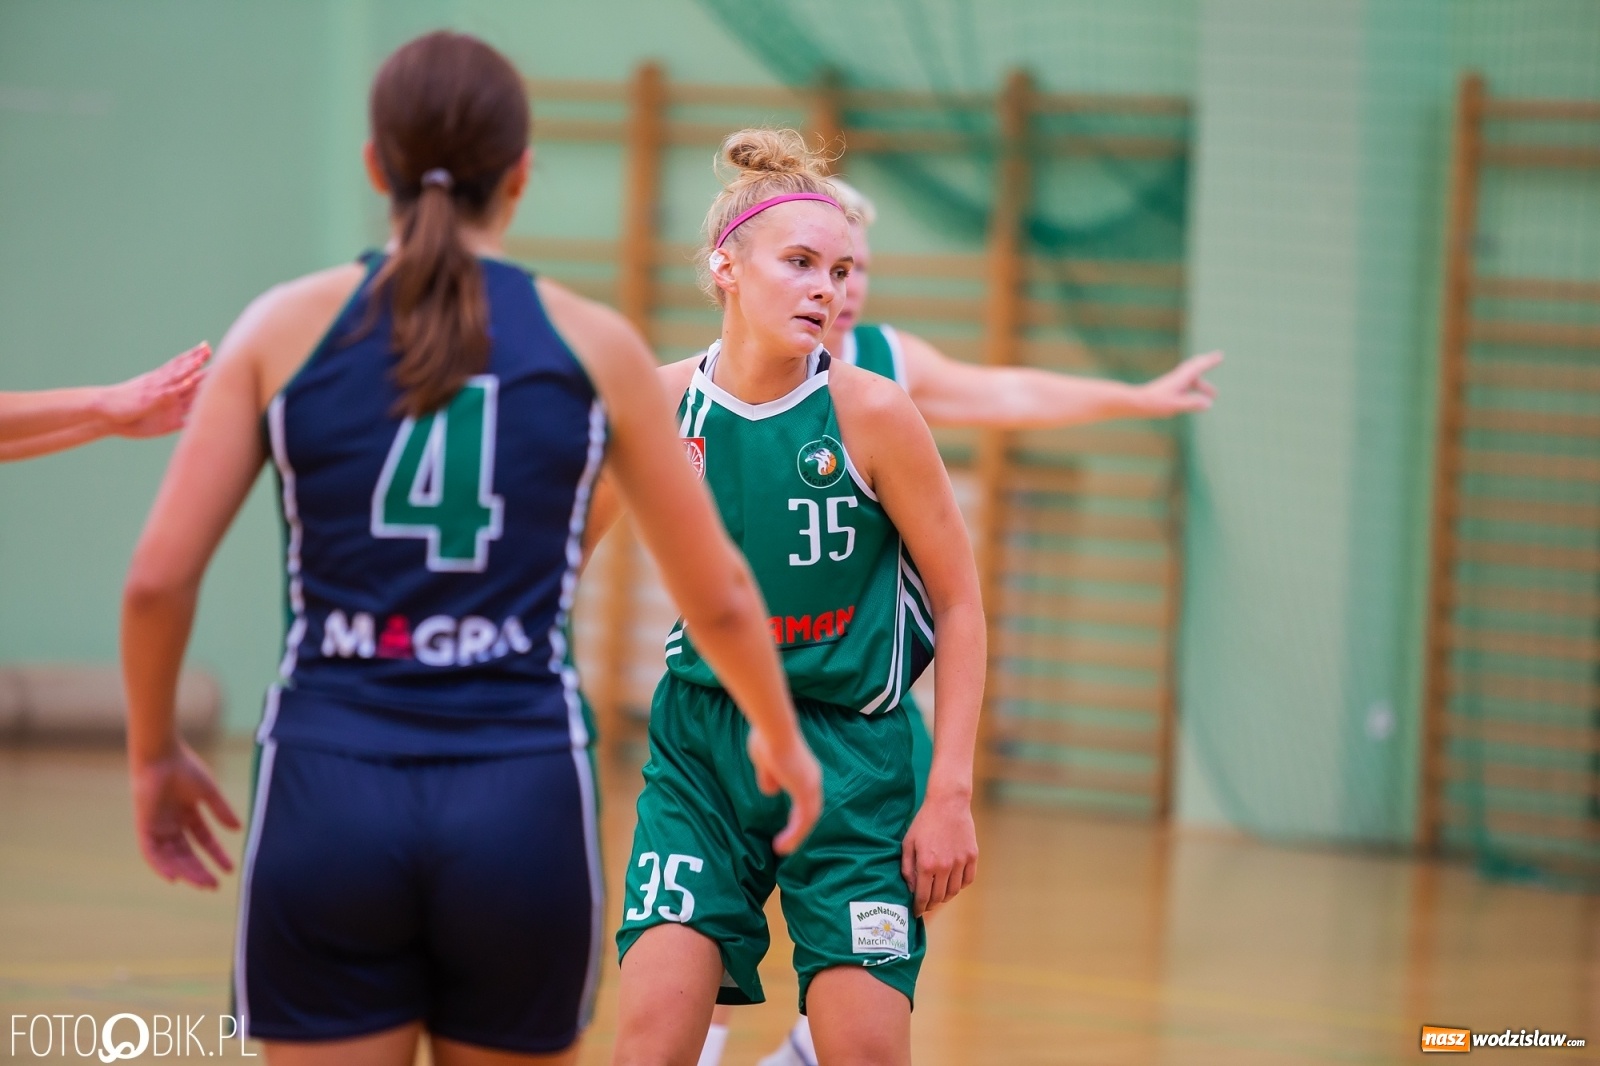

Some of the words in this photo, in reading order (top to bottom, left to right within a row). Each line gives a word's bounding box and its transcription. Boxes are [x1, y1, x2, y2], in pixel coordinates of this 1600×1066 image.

[371, 374, 504, 573] 4
[788, 496, 858, 566] 35
[321, 608, 532, 667] MAGRA
[766, 605, 855, 644] AMAN
[626, 851, 704, 923] 35
[856, 906, 907, 927] MoceNatury.pl
[857, 936, 887, 946] Marcin
